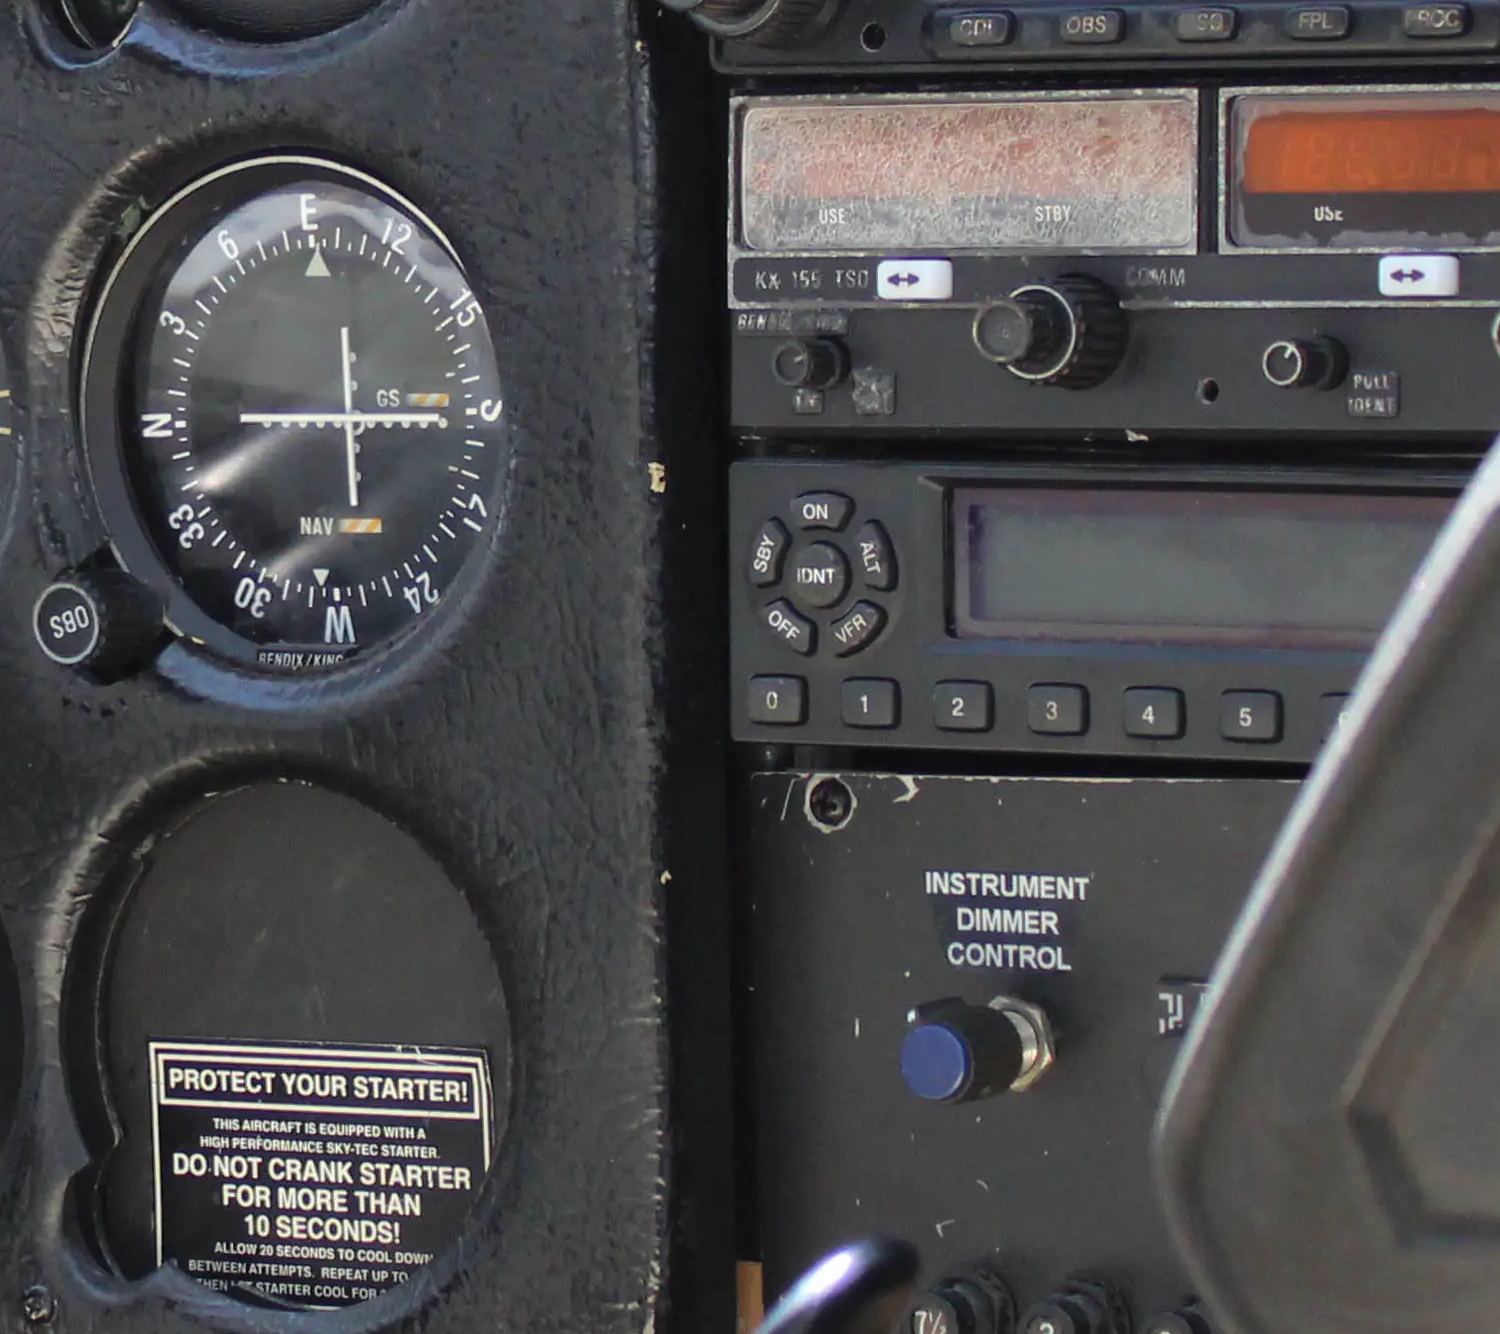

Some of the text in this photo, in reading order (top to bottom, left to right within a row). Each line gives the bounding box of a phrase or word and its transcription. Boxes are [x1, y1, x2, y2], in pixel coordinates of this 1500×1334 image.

[300, 194, 317, 231] E
[377, 388, 401, 408] GS
[300, 517, 334, 536] NAV
[803, 503, 829, 520] ON
[753, 536, 775, 573] SBY
[859, 541, 881, 576] ALT
[796, 567, 836, 586] IDNT
[234, 583, 272, 619] 30
[49, 608, 90, 639] OBS
[767, 609, 802, 641] OFF
[835, 613, 868, 645] VFR
[925, 871, 1090, 901] INSTRUMENT
[956, 908, 1060, 936] DIMMER
[947, 942, 1072, 971] CONTROL
[169, 1067, 469, 1103] PROTECT YOUR STARTER!
[213, 1117, 414, 1140] THIS AIRCRAFT EQUIPPED WITH
[200, 1134, 379, 1156] HIGH PERFORMANCE SKY-TEC
[173, 1153, 471, 1191] DO NOT CRANK STARTER
[223, 1183, 421, 1216] FOR MORE THAN
[244, 1215, 401, 1245] 10 SECONDS!
[214, 1242, 393, 1264] ALLOW SECONDS COOL
[188, 1259, 369, 1281] BETWEEN REPEAT
